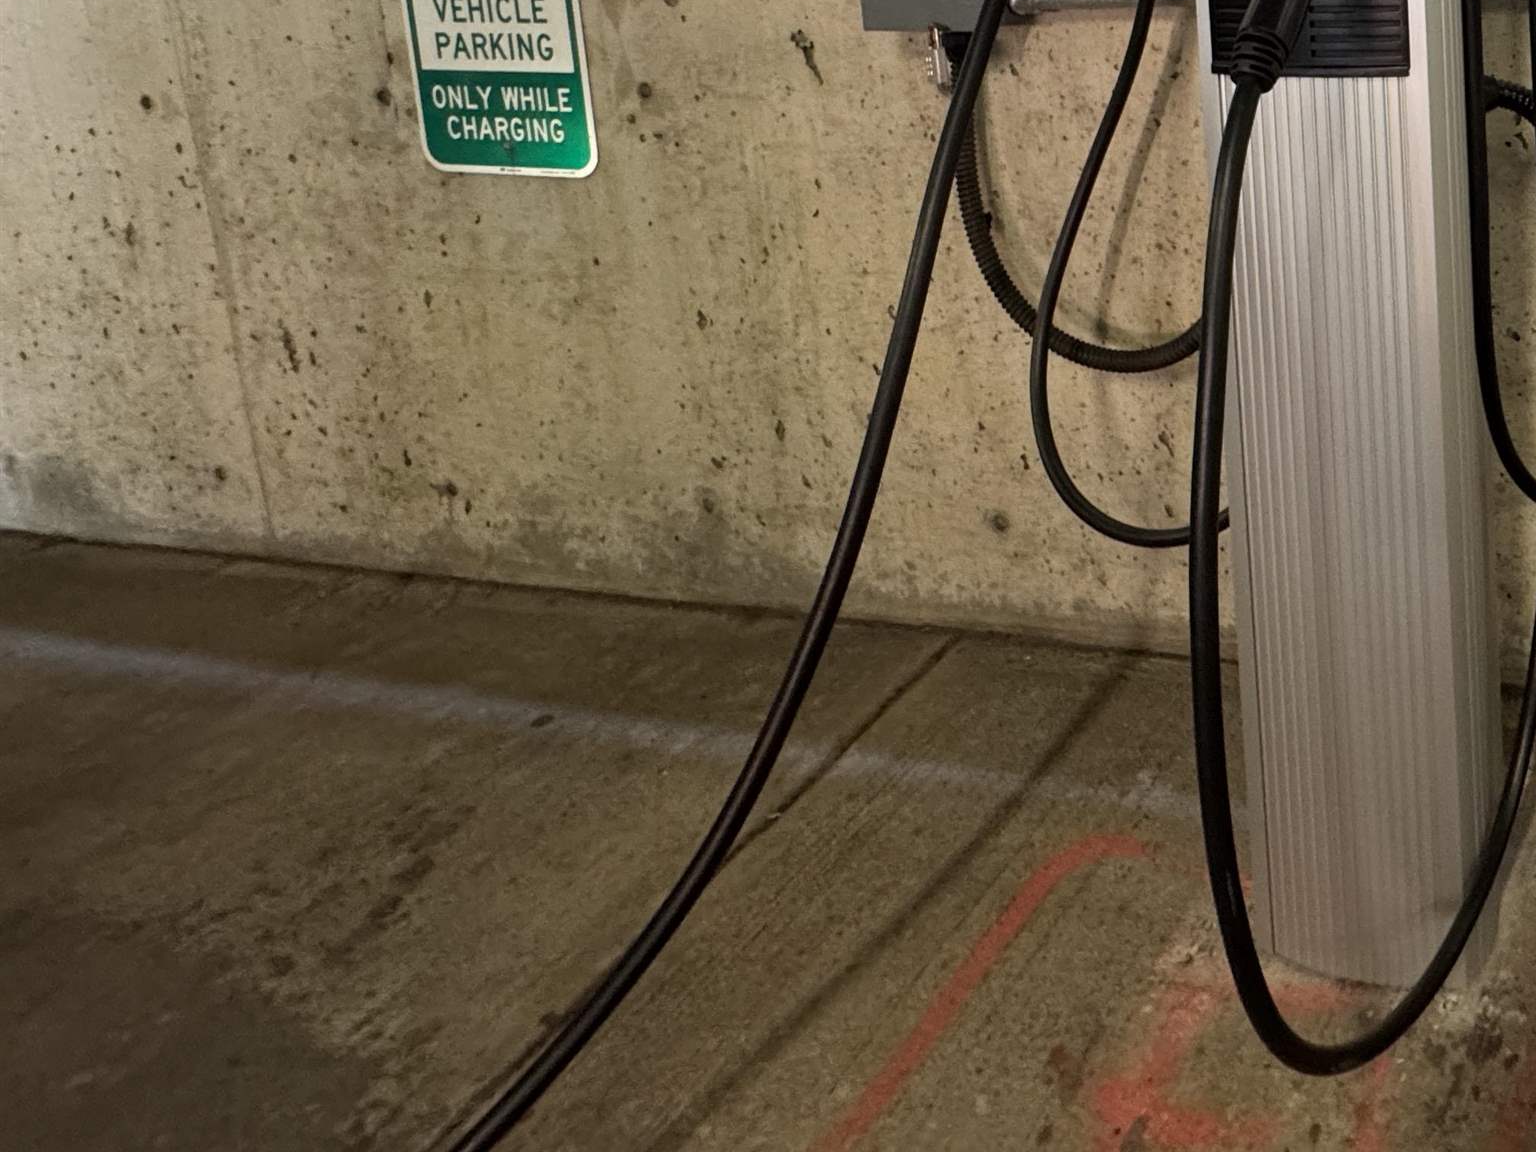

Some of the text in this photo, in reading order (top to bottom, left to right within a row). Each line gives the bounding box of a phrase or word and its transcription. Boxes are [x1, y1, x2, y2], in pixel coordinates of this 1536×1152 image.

[436, 33, 554, 61] PARKING
[431, 85, 573, 113] ONLY WHILE
[447, 116, 565, 143] CHARGING
